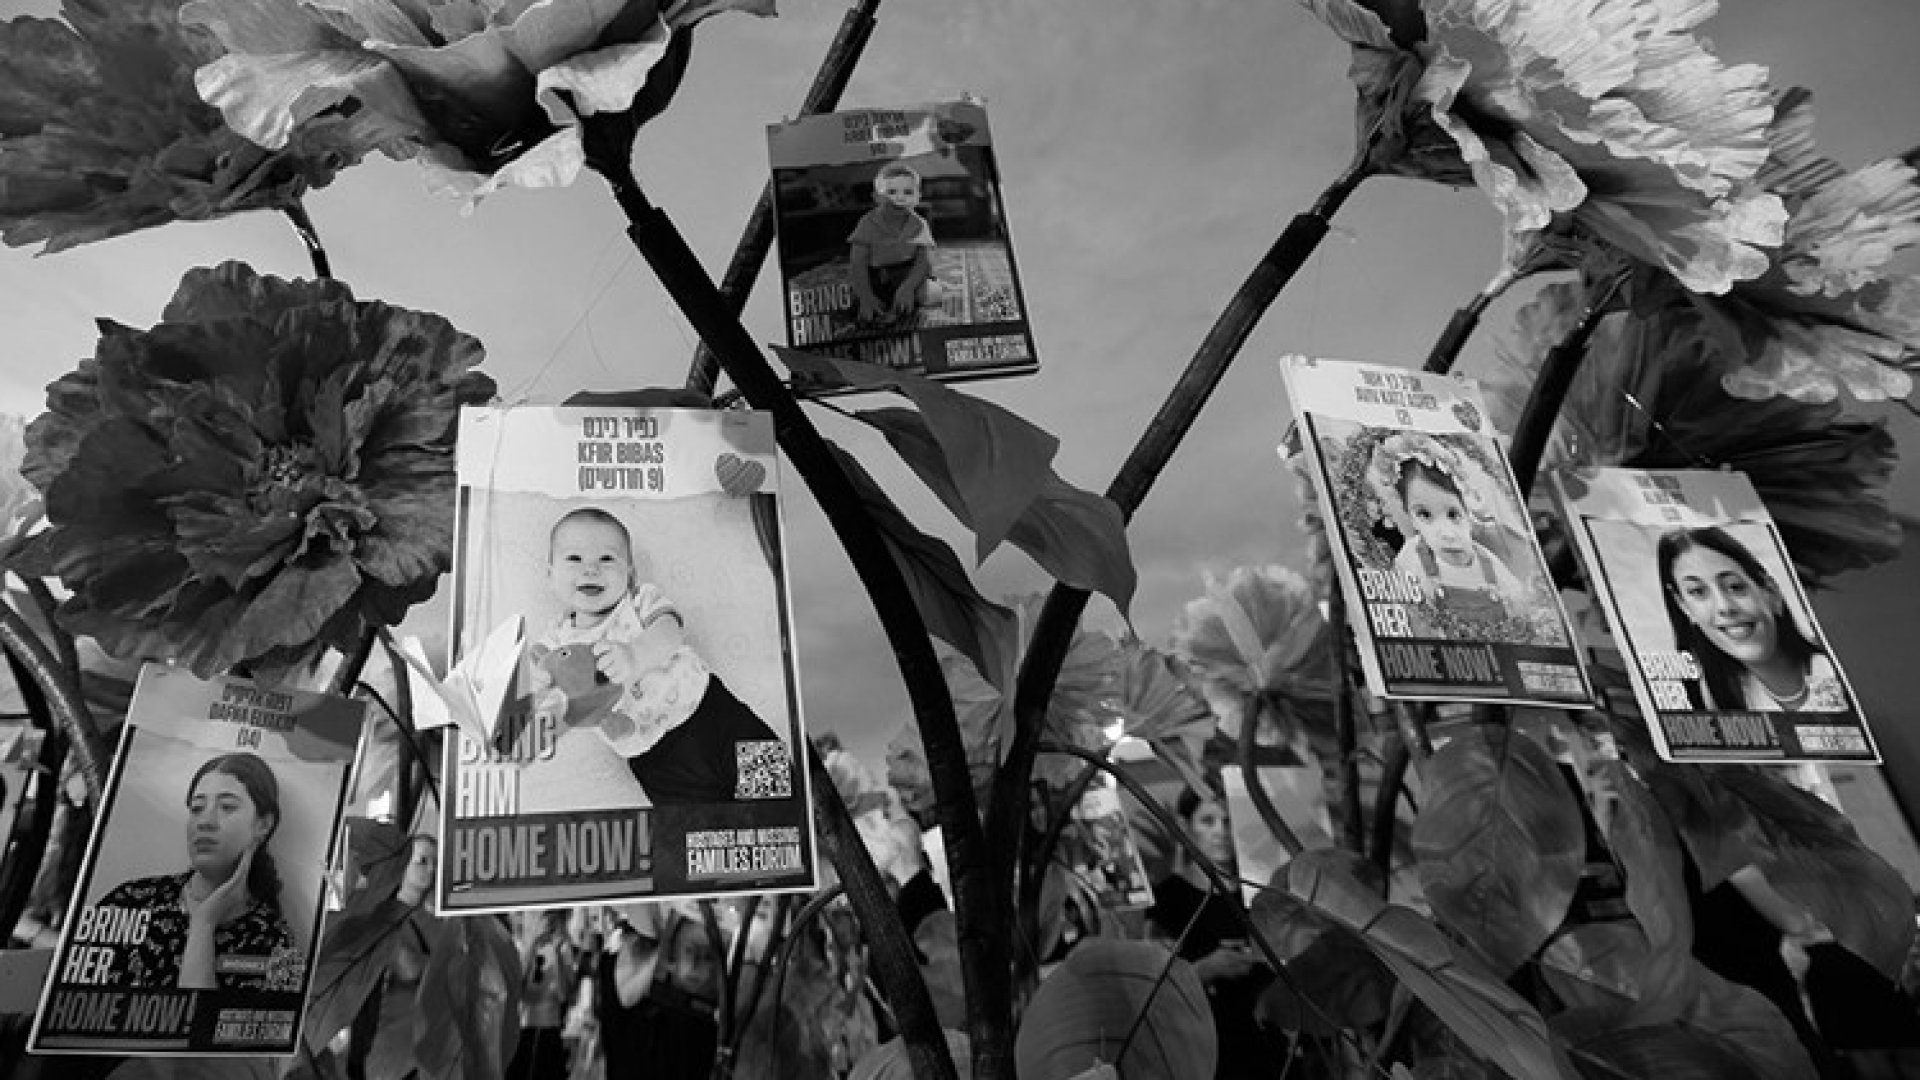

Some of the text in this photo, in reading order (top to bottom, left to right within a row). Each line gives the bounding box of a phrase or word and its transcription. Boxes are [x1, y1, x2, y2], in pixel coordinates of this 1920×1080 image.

[791, 283, 851, 316] BRING
[793, 315, 832, 346] HIM
[583, 416, 658, 438] כפיר ביבס
[578, 441, 664, 463] KFIR BIBAS
[1358, 570, 1422, 602] BRING
[1369, 603, 1413, 638] HER
[1379, 643, 1443, 679] HOME
[456, 766, 518, 820] HIM
[453, 811, 652, 882] HOME NOW!
[687, 845, 801, 875] FAMILIES FORUM
[74, 905, 150, 945] BRING
[61, 945, 115, 984] HER
[49, 990, 198, 1034] HOME NOW!
